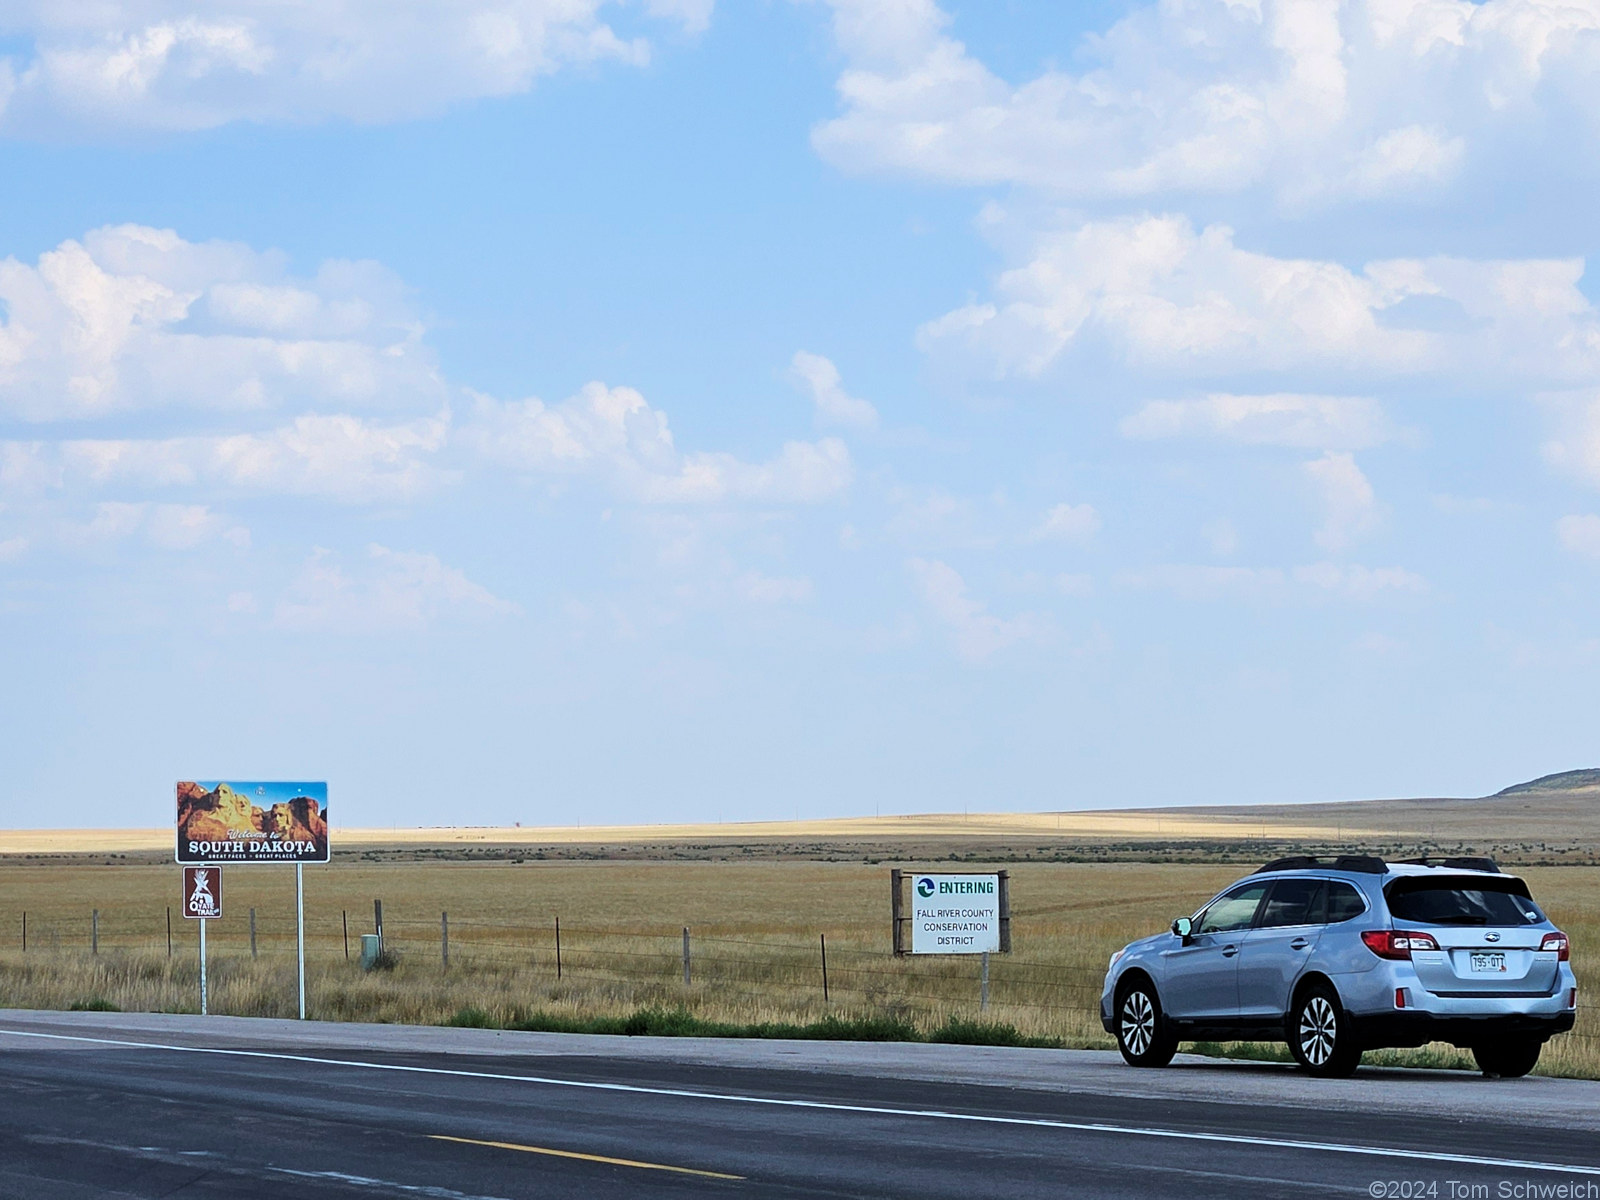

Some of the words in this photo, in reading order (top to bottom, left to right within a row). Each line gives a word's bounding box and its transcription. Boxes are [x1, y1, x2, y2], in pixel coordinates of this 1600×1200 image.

[227, 829, 267, 840] Welcome
[269, 831, 280, 840] to
[189, 841, 244, 853] SOUTH
[249, 841, 316, 853] DAKOTA
[939, 882, 993, 894] ENTERING
[917, 909, 936, 917] FALL
[937, 909, 960, 917] RIVER
[961, 909, 994, 917] COUNTY
[923, 923, 988, 931] CONSERVATION
[937, 937, 975, 945] DISTRICT
